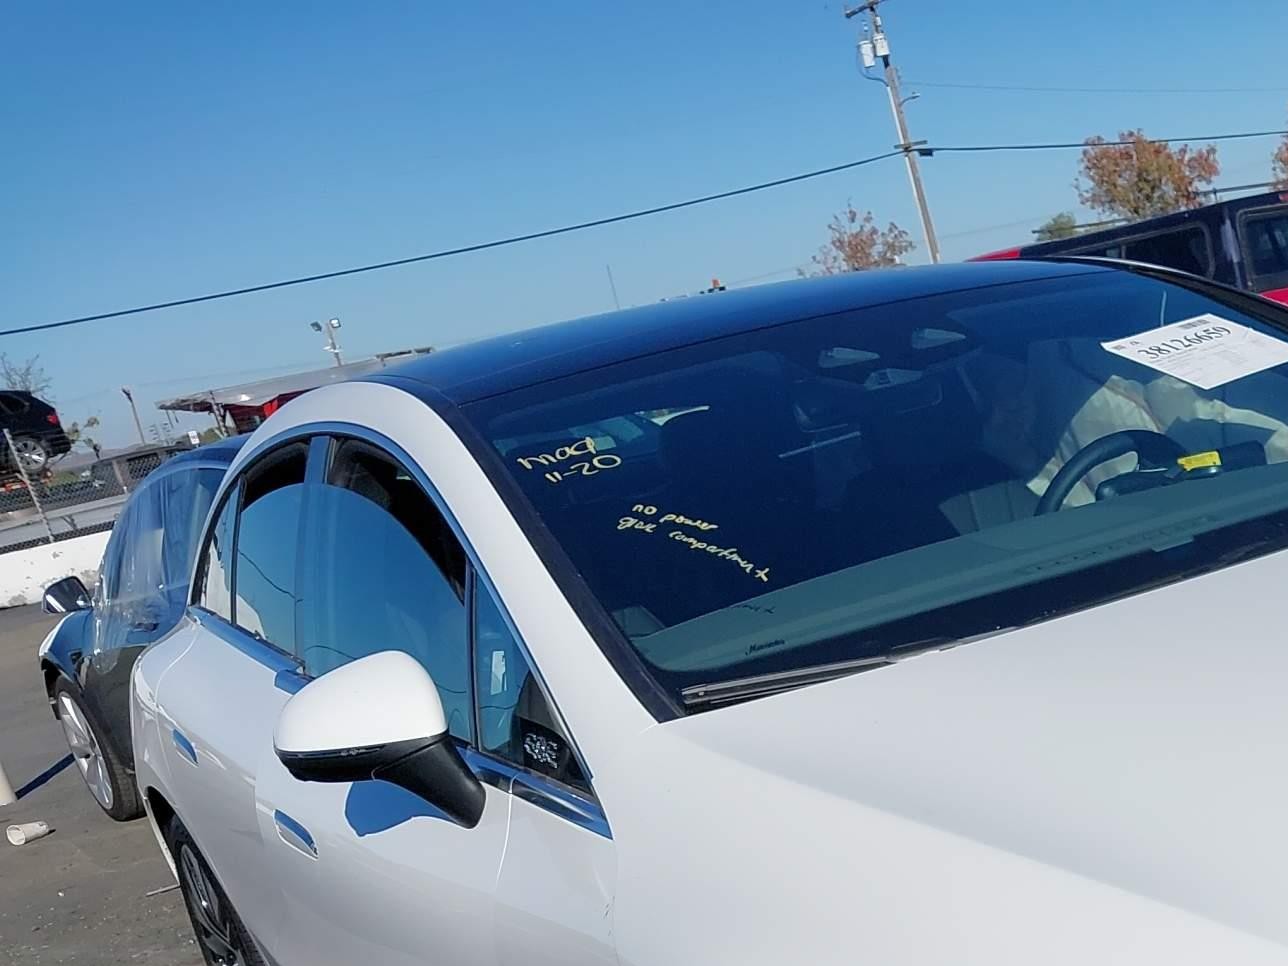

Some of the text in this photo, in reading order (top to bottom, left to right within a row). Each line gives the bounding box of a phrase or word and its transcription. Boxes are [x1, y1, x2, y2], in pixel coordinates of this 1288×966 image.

[1137, 326, 1232, 360] 38126659
[544, 454, 622, 483] 11-20
[631, 503, 658, 516] no
